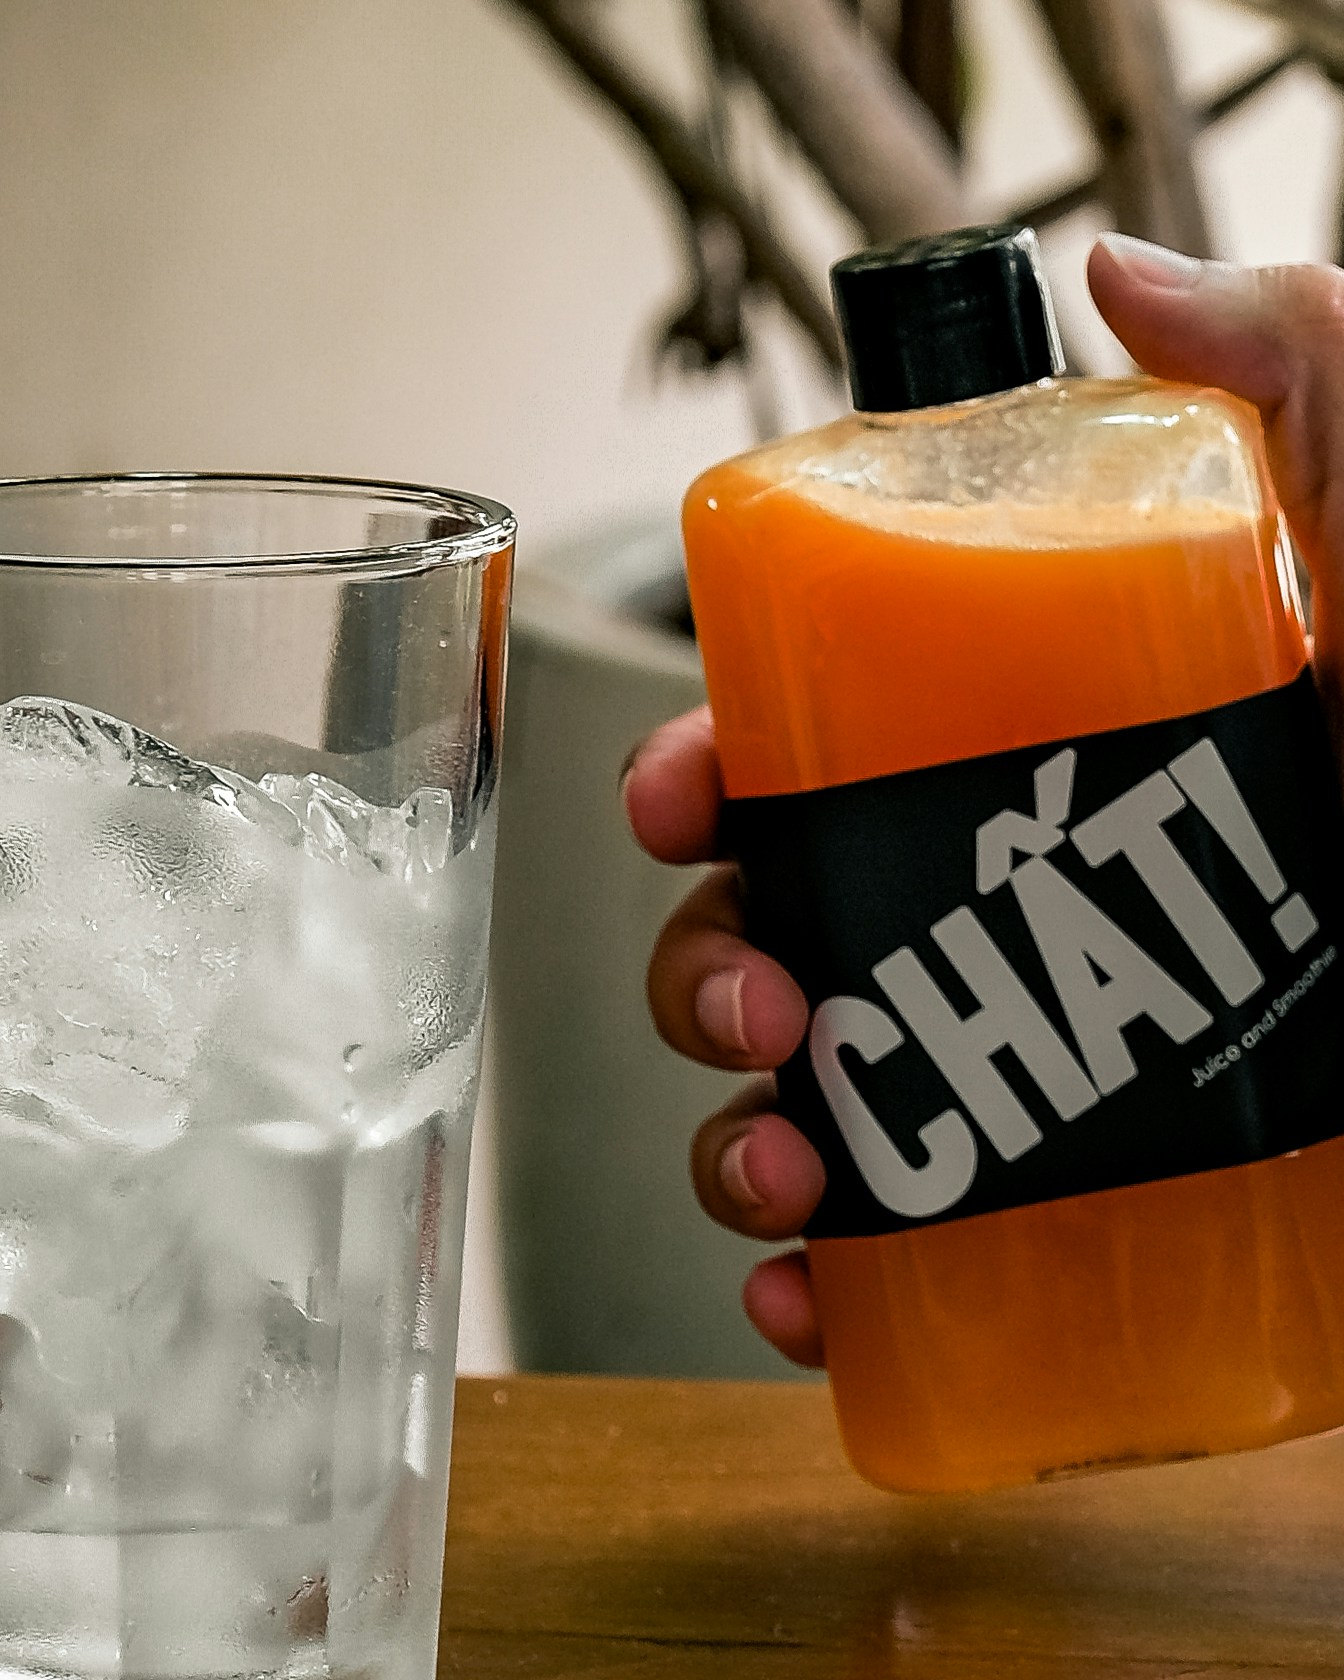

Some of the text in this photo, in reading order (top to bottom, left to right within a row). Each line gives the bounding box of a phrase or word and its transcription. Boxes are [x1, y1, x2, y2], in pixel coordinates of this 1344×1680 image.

[811, 737, 1319, 1217] CHẤT!
[1191, 945, 1337, 1088] Juice and Smoothie
